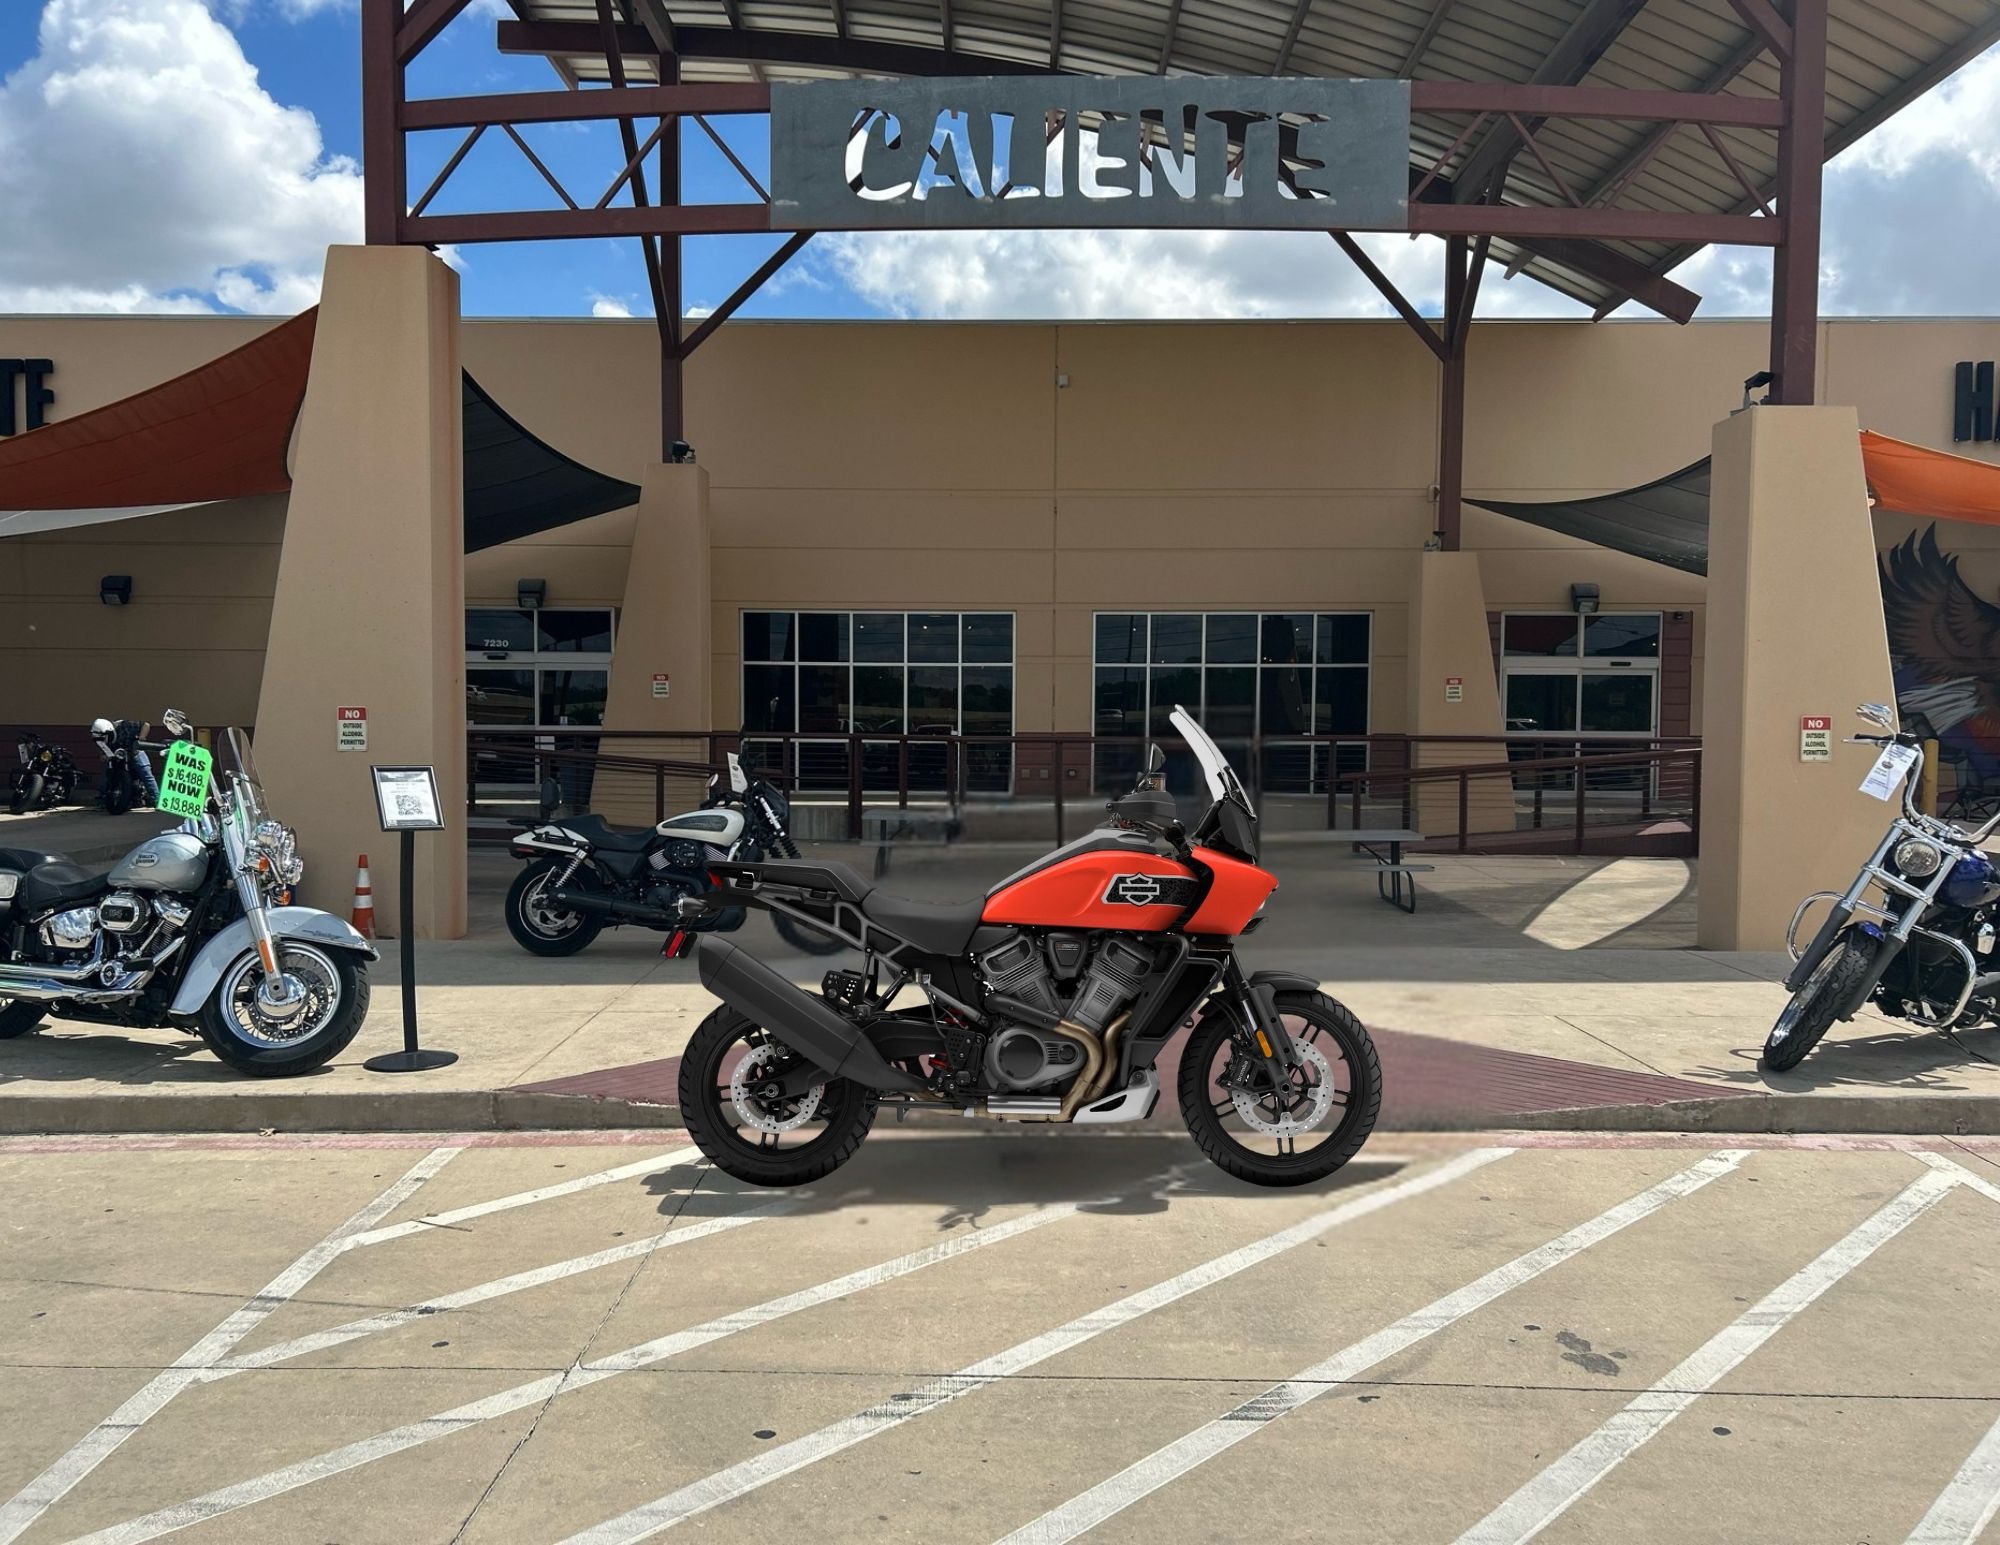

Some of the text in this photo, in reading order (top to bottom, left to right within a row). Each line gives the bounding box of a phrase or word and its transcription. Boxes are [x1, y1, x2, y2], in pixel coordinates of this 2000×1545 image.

[845, 104, 1331, 200] CALIENTE
[1954, 361, 2000, 442] H
[483, 639, 509, 648] 7230
[344, 709, 360, 719] NO
[1808, 719, 1824, 729] NO
[175, 752, 206, 771] WAS
[167, 779, 201, 799] NOW
